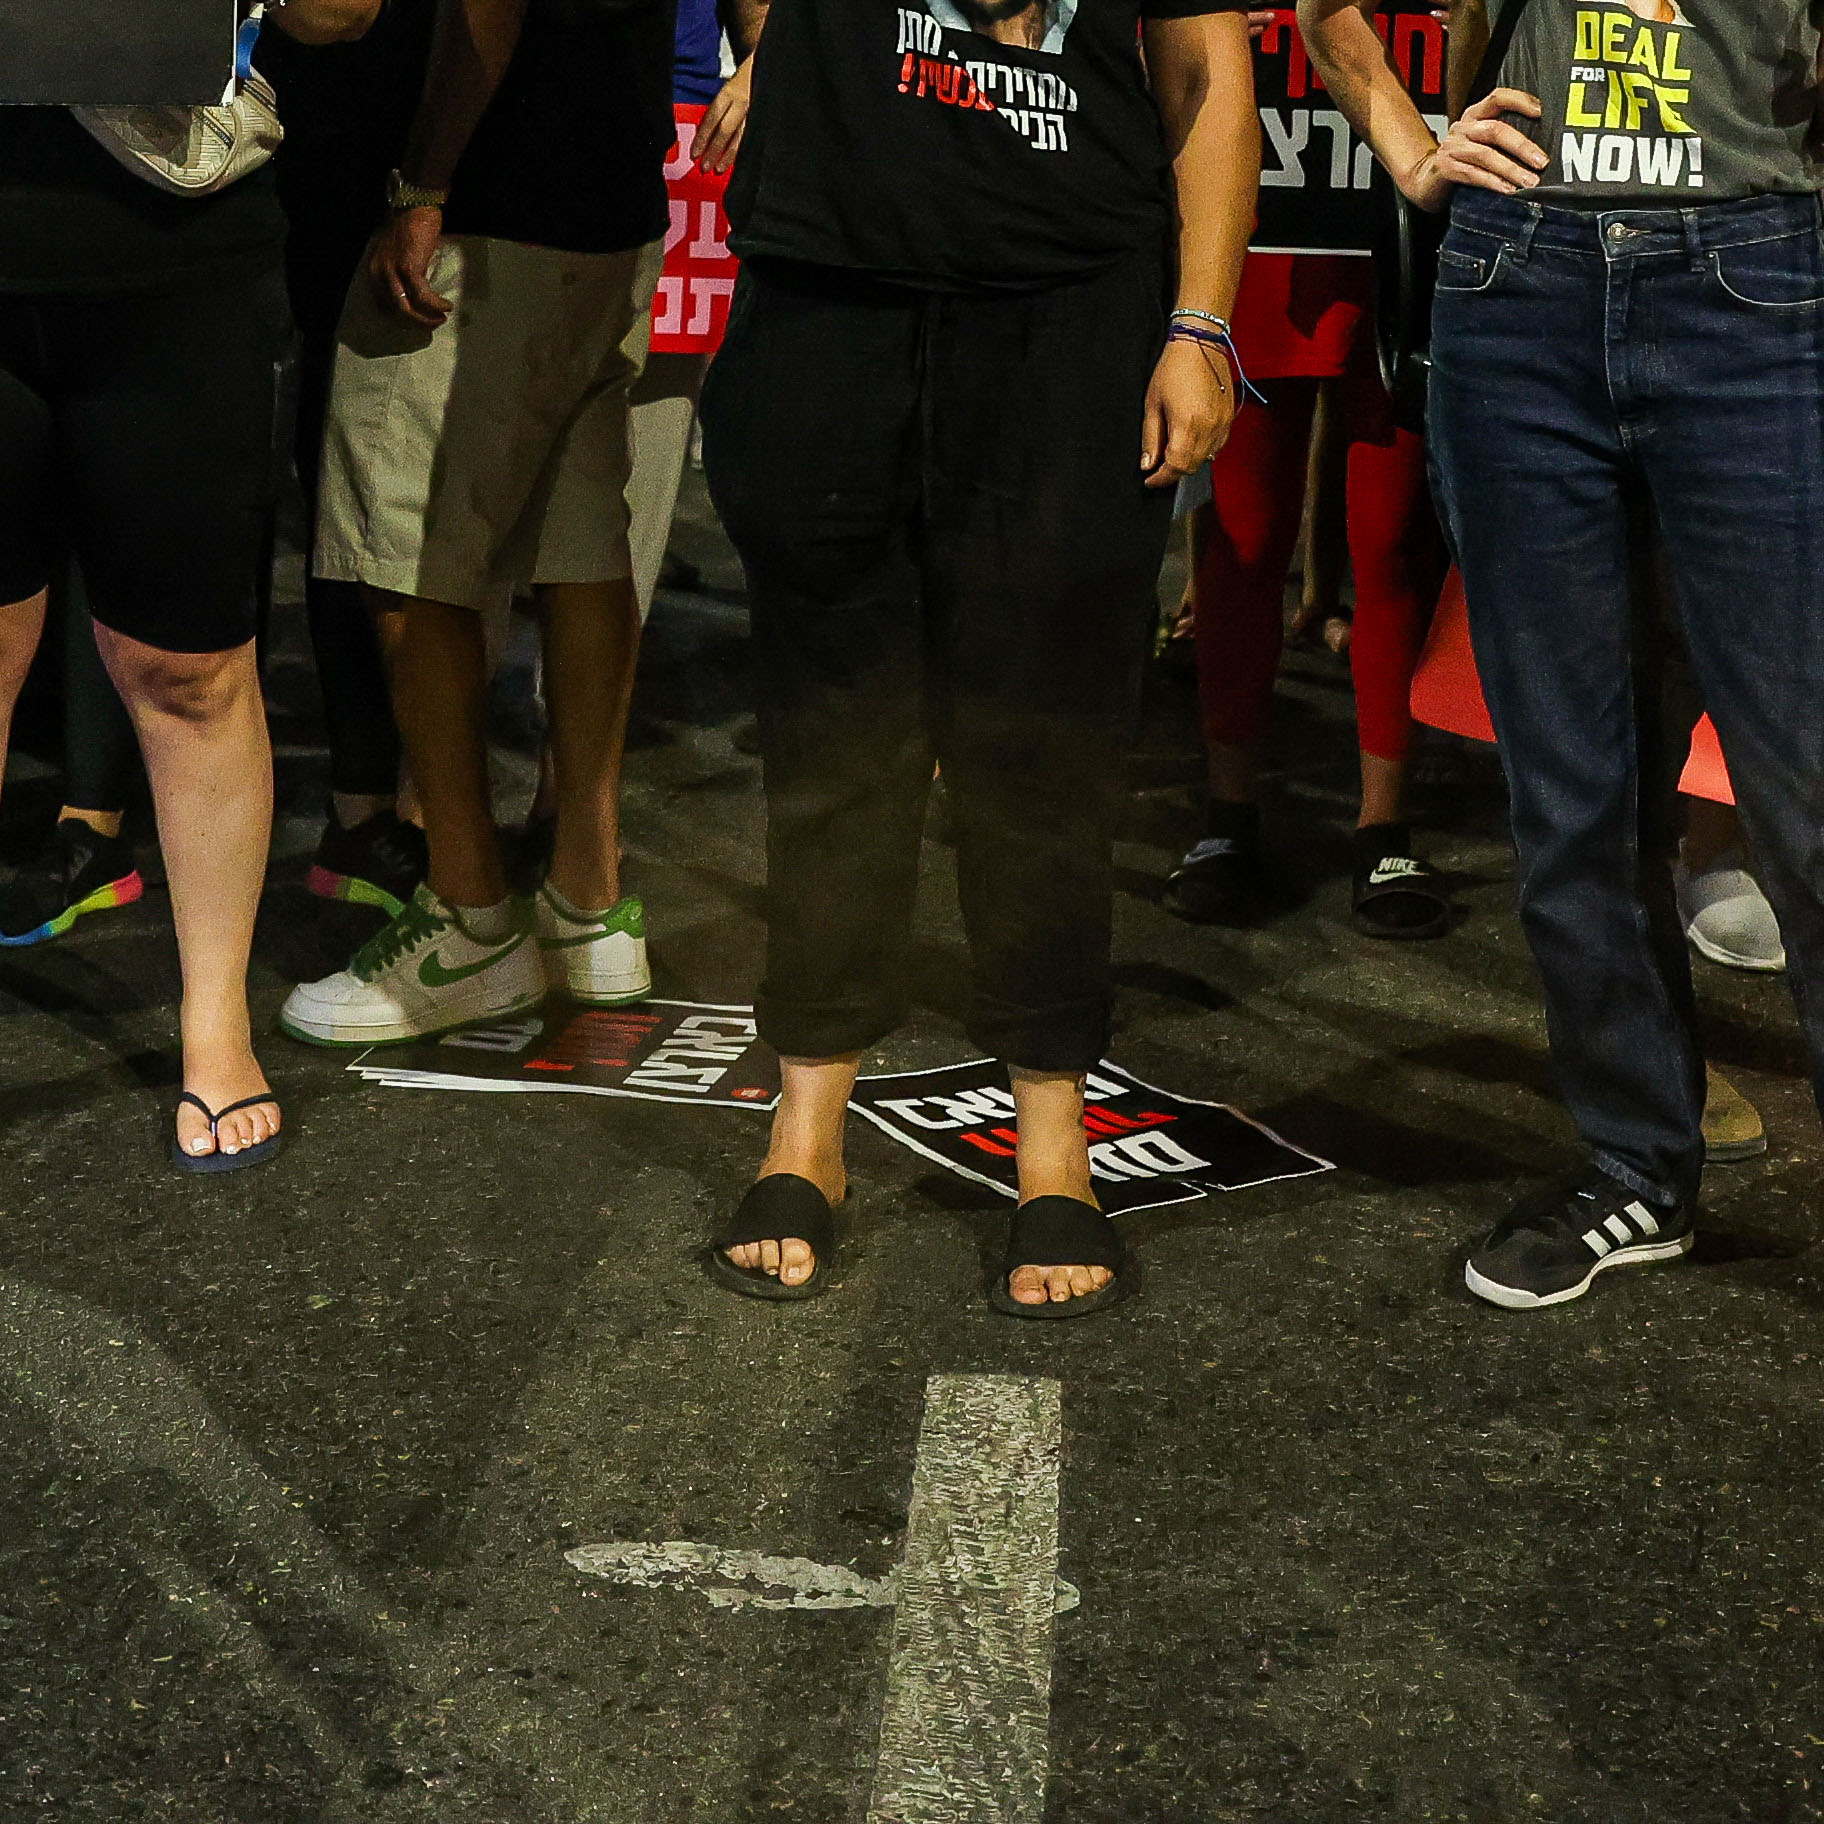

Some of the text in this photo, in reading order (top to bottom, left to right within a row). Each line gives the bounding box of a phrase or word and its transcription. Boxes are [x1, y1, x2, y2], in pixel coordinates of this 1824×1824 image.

[896, 7, 943, 56] מתן
[1573, 10, 1692, 81] DEAL
[1564, 69, 1698, 135] LIFE
[1570, 66, 1606, 82] FOR
[1561, 132, 1704, 188] NOW!
